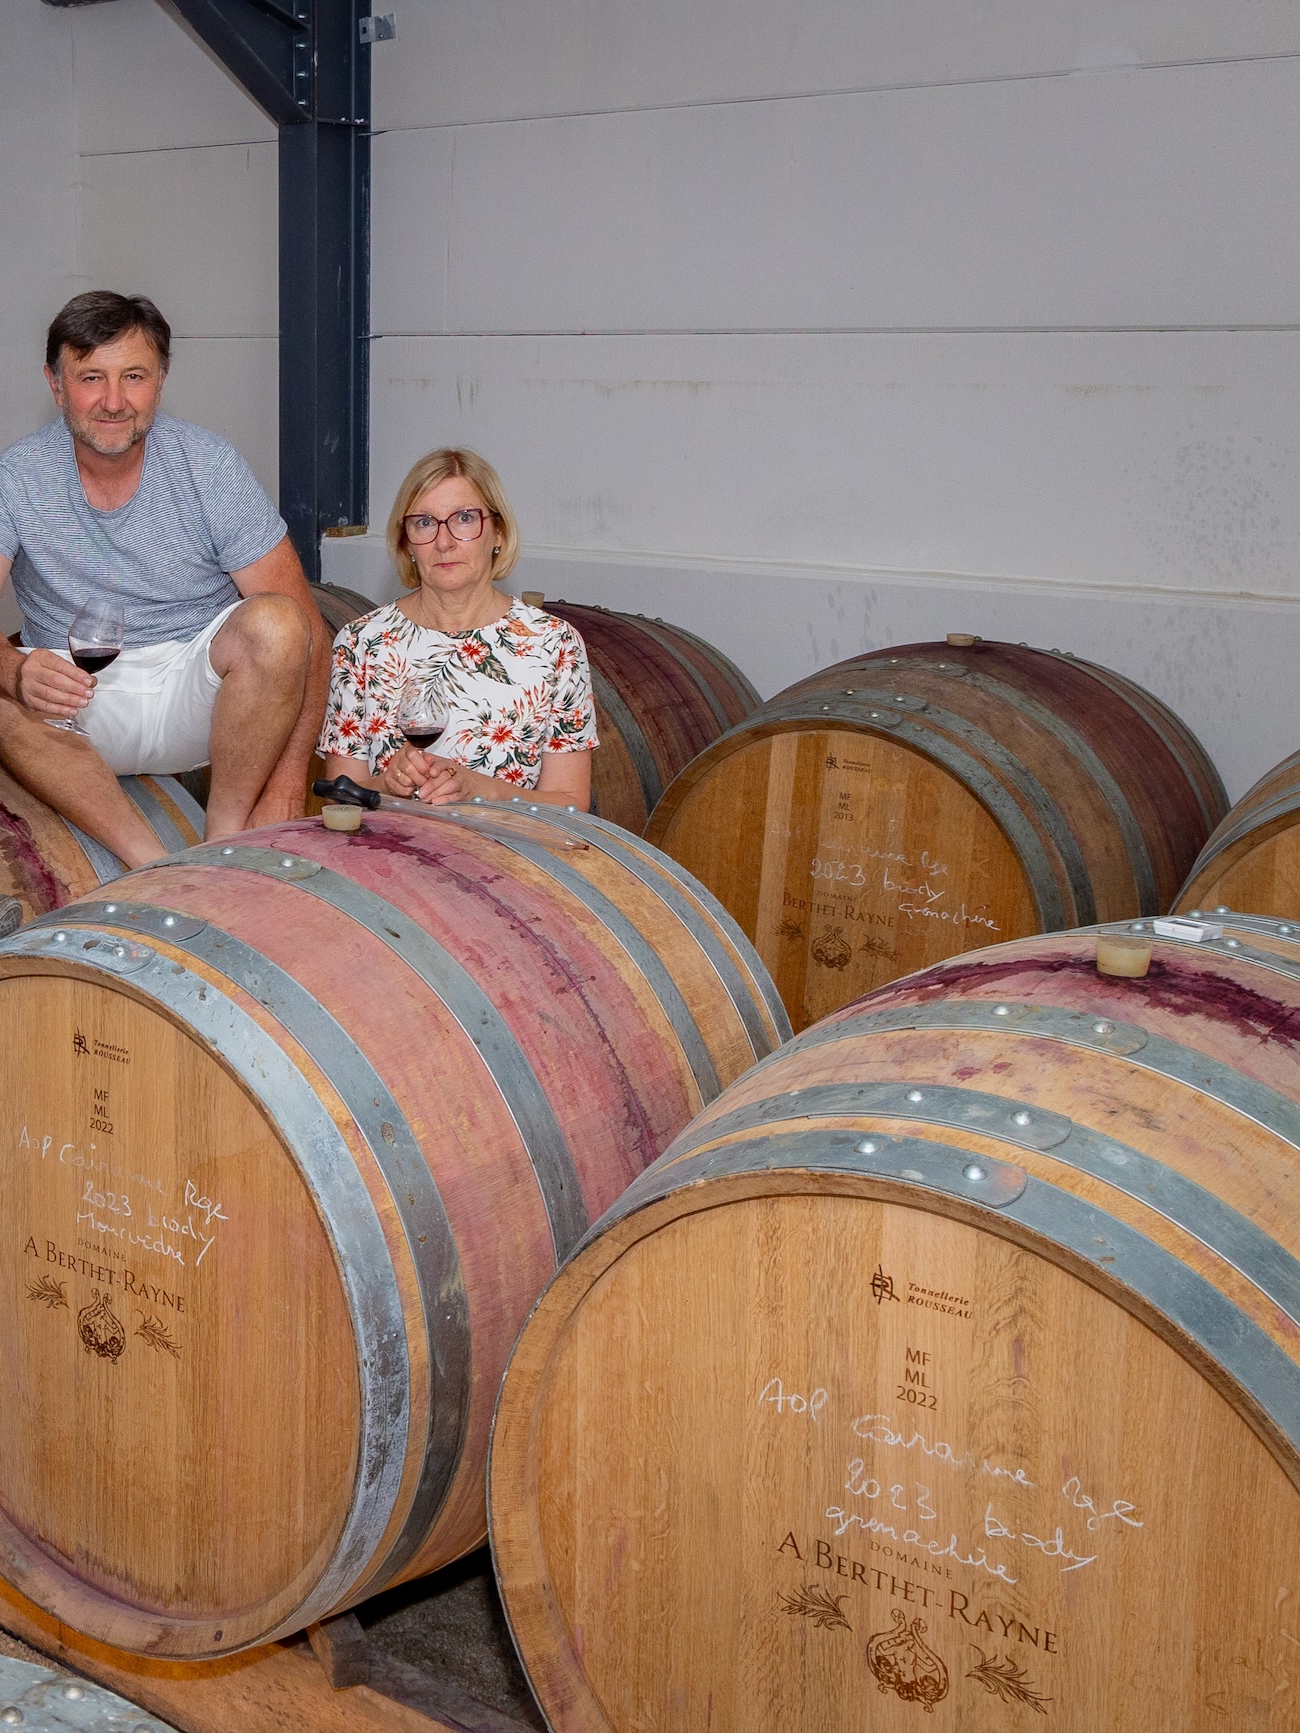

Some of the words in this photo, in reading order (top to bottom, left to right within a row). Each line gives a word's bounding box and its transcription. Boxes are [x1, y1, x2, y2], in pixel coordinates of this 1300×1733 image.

[833, 811, 854, 822] 2013
[815, 889, 858, 902] DOMAINE
[93, 1048, 131, 1065] ROUSSEAU
[94, 1039, 129, 1055] Tonnellerie
[93, 1087, 109, 1102] MF
[93, 1103, 109, 1118] ML
[89, 1117, 114, 1135] 2022
[81, 1180, 133, 1217] 2023
[77, 1237, 127, 1262] DOMAINE
[908, 1282, 970, 1307] Tonnellerie
[907, 1295, 973, 1320] ROUSSEAU
[905, 1346, 932, 1367] MF
[904, 1367, 931, 1389] ML
[896, 1385, 938, 1411] 2022
[845, 1457, 937, 1520] 2023
[869, 1540, 954, 1580] DOMAINE
[814, 1538, 1059, 1655] BERTHET-RAYNE
